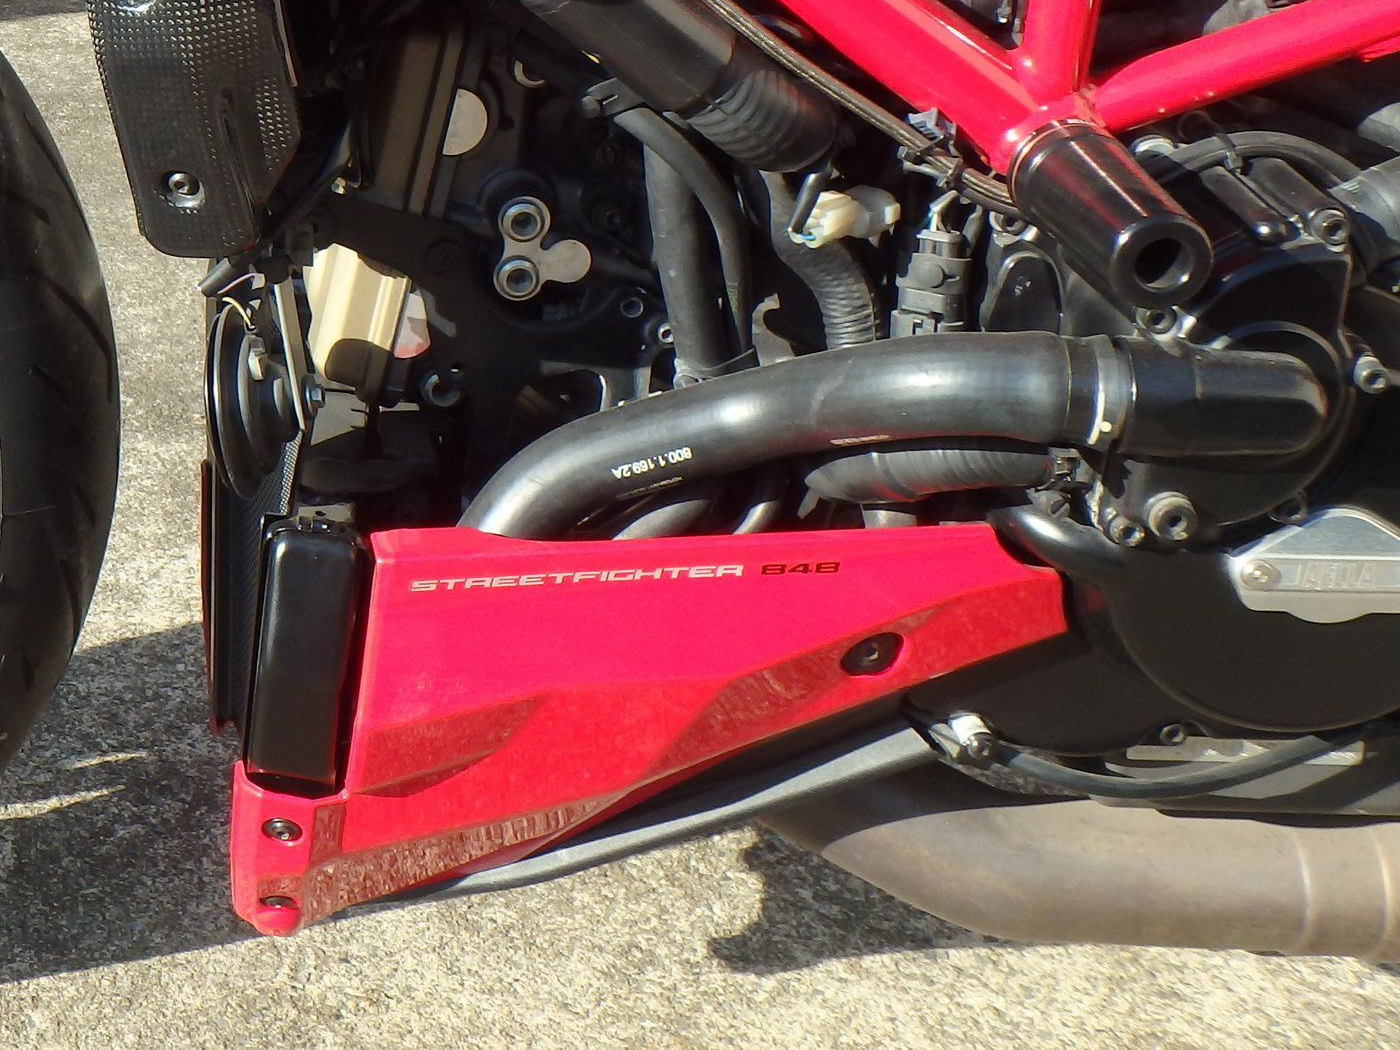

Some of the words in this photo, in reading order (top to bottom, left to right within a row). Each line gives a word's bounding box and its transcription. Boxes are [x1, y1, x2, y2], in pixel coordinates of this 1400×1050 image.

[610, 446, 693, 480] 800.1.169.2A
[410, 564, 745, 592] STREETFIGHTER
[760, 561, 841, 576] 848
